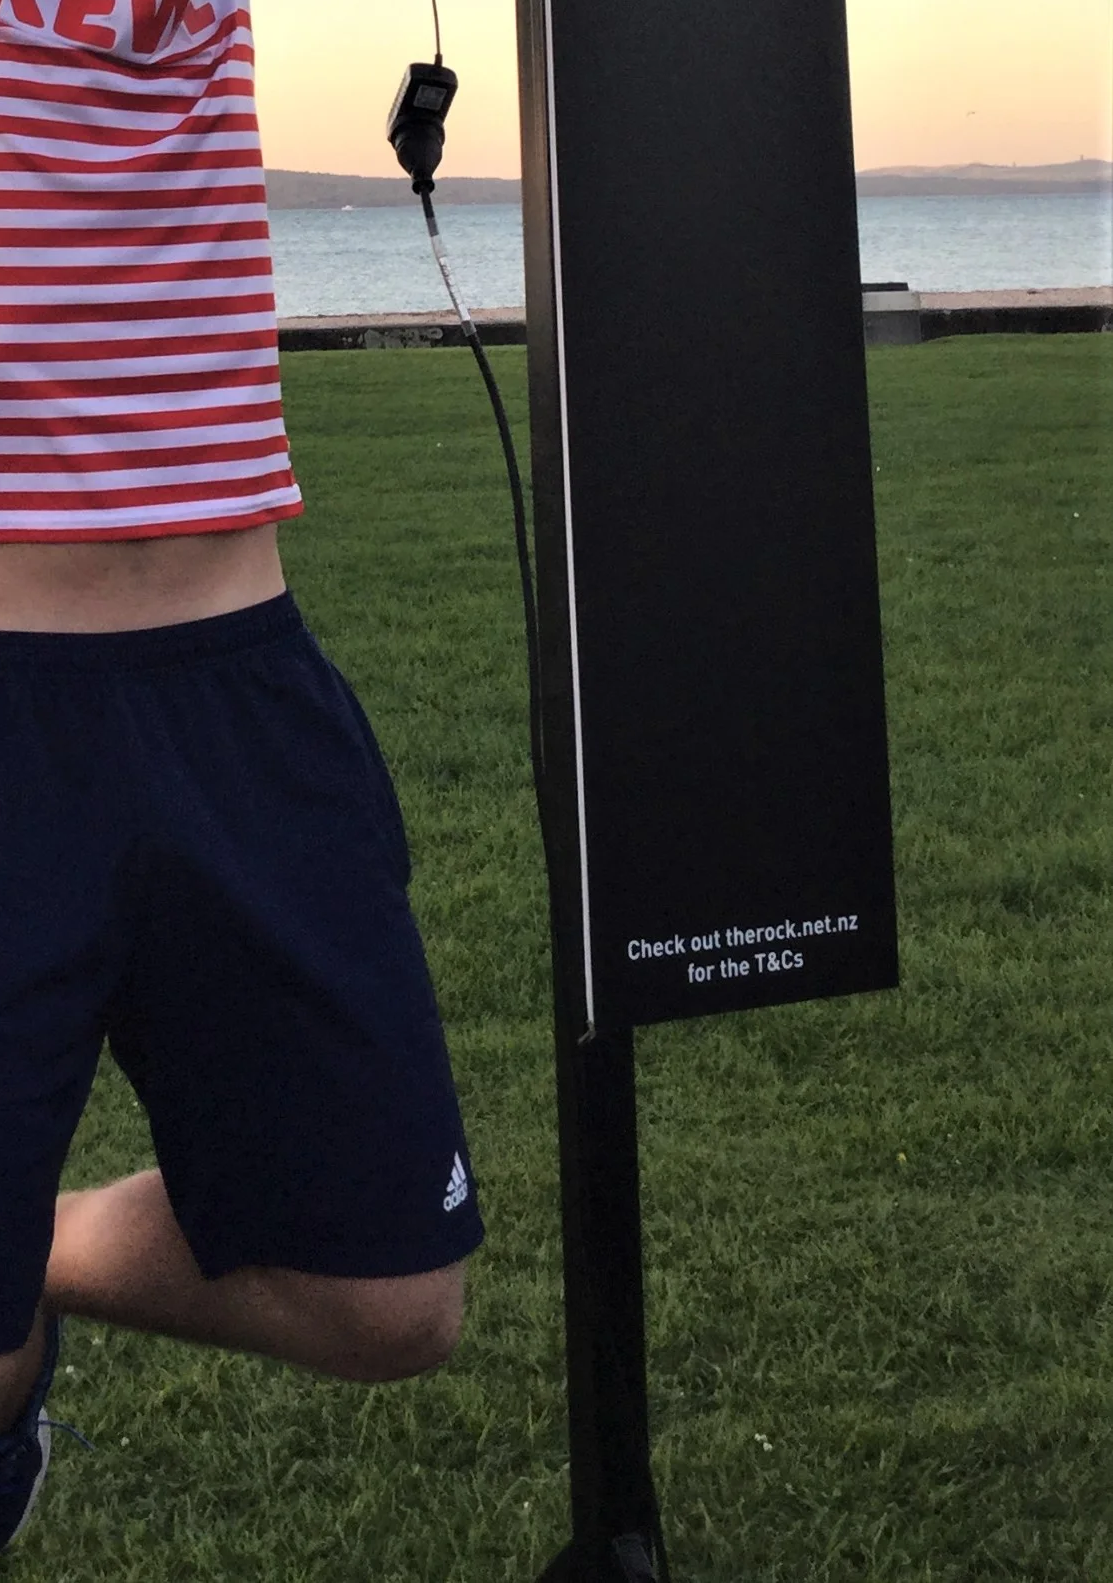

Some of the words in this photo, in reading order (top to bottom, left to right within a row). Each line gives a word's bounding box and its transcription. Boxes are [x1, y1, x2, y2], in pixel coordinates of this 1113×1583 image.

[627, 934, 686, 961] Check
[690, 930, 721, 952] out
[725, 915, 858, 947] therock.net.nz
[687, 963, 715, 983] for
[719, 957, 750, 979] the
[754, 949, 804, 973] T&Cs
